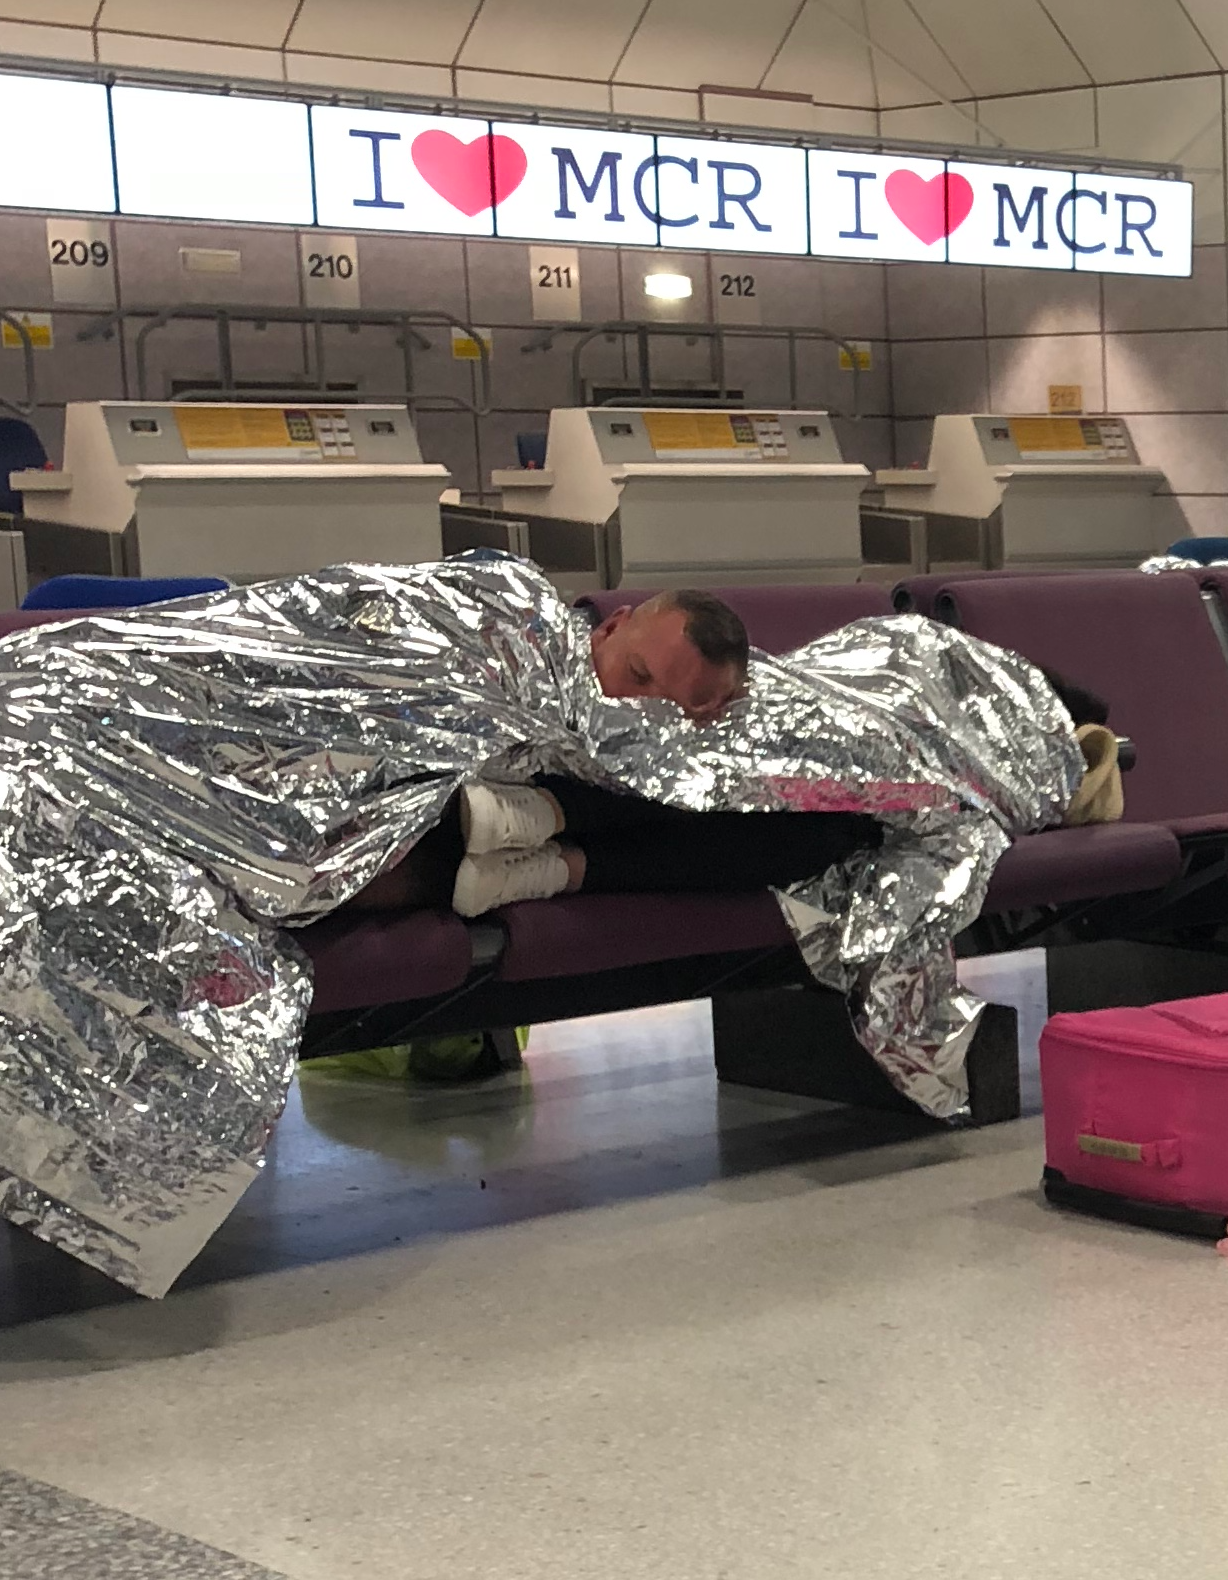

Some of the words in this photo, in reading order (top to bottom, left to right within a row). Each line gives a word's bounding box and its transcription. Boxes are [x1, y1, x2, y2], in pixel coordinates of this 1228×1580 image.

[349, 129, 405, 209] I
[551, 147, 772, 233] MCR
[837, 169, 878, 240] I
[992, 183, 1163, 257] MCR
[50, 239, 110, 268] 209
[308, 253, 353, 280] 210
[538, 265, 573, 289] 211
[719, 273, 756, 298] 212
